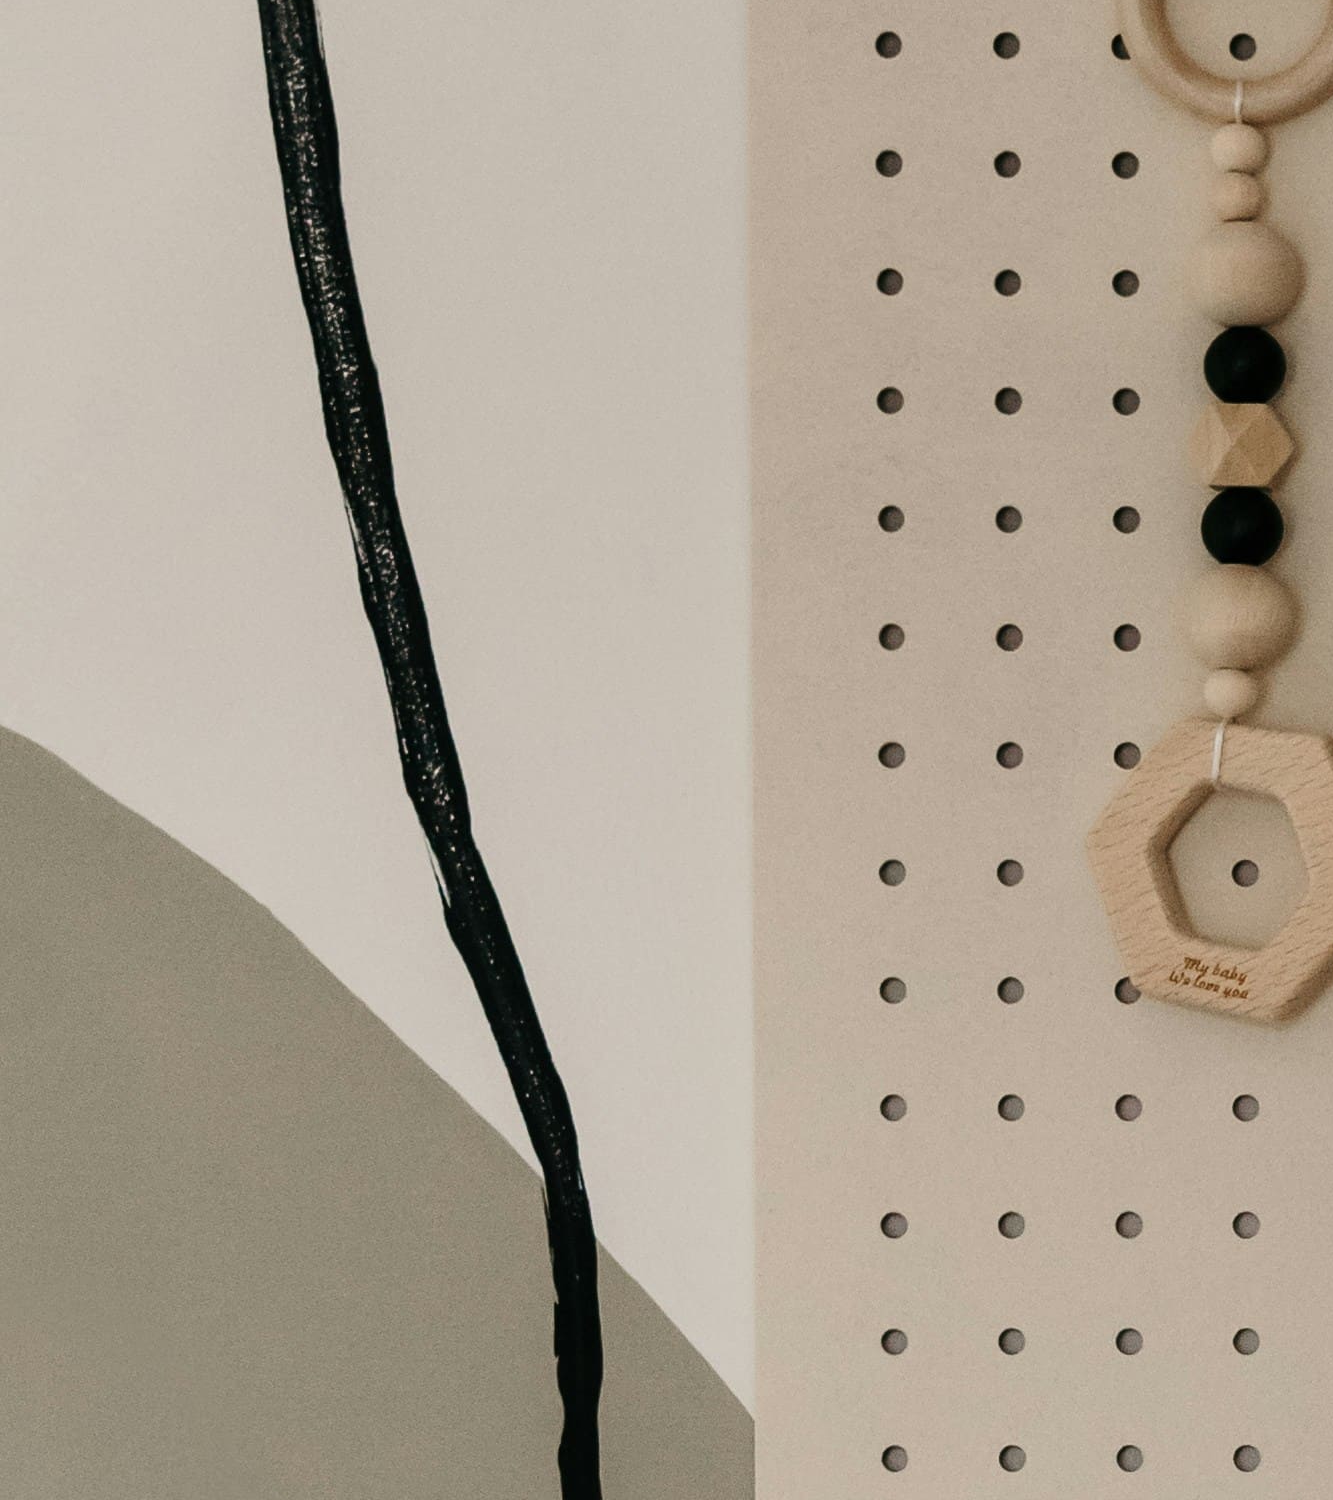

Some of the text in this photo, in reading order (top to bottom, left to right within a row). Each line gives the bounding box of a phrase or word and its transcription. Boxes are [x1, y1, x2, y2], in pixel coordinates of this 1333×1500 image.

[1168, 970, 1191, 986] We
[1223, 987, 1249, 999] you
[1183, 956, 1248, 986] My baby
